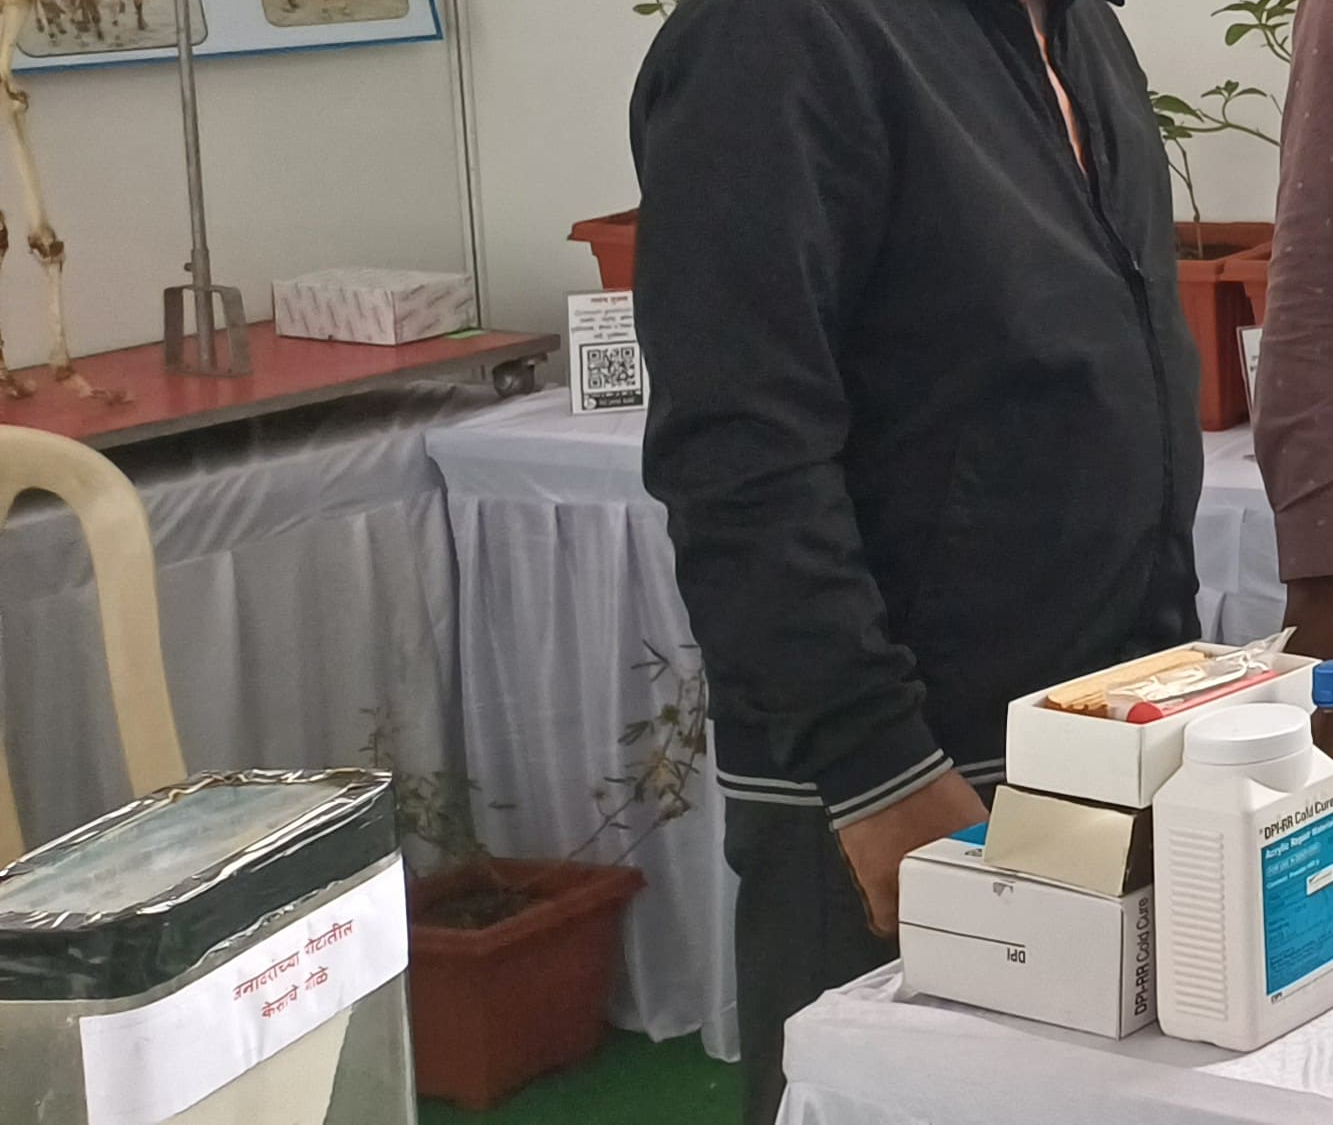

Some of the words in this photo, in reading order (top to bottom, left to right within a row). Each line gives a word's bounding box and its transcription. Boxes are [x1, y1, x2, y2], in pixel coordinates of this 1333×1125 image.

[1295, 804, 1314, 825] Cold
[1135, 896, 1149, 930] Cure
[1006, 947, 1026, 964] DPI
[1135, 930, 1150, 963] Cold
